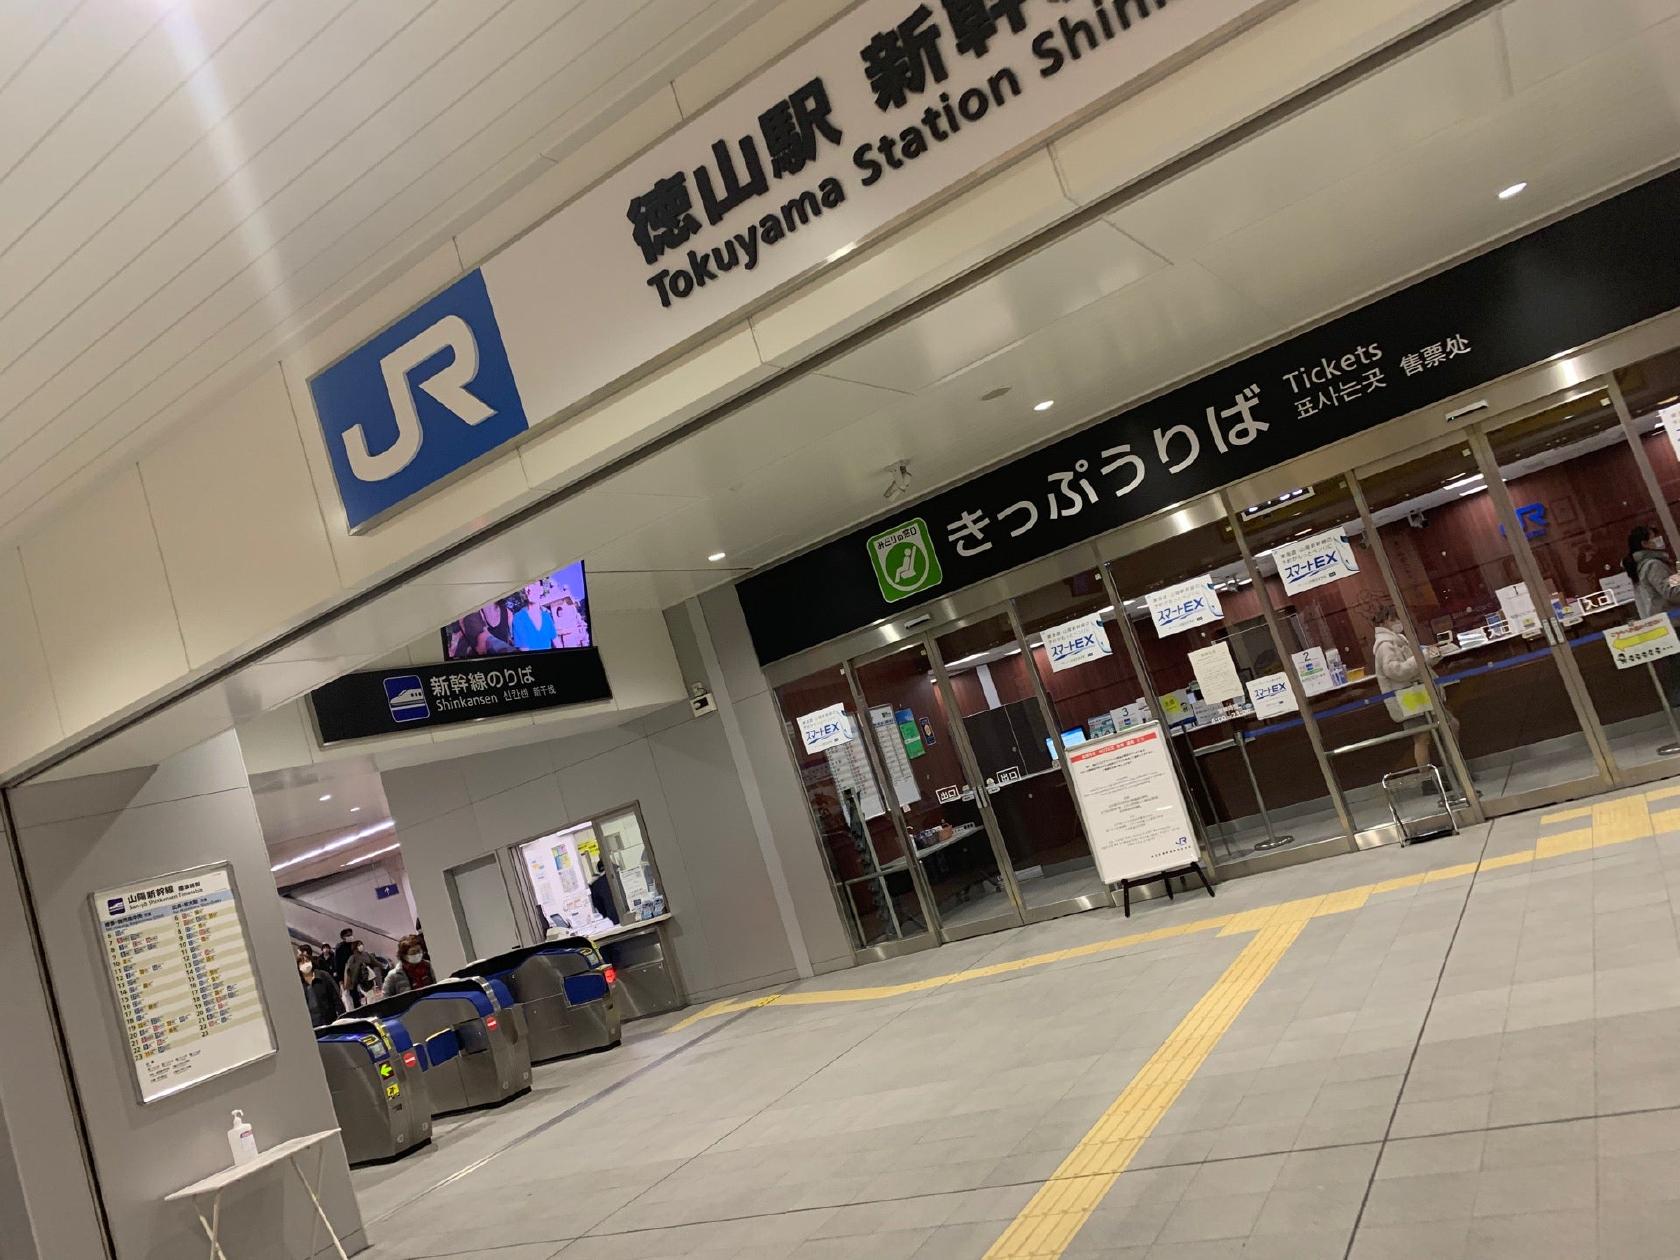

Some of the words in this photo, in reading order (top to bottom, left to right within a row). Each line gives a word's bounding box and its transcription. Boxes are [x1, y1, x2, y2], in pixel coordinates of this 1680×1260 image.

[647, 174, 846, 307] Tokuyama
[852, 64, 1021, 186] Station
[1031, 0, 1168, 78] Shin
[626, 76, 843, 264] 徳山駅
[1283, 343, 1383, 393] Tickets
[1400, 333, 1472, 377] 售票处
[341, 314, 497, 482] JR
[945, 383, 1271, 559] きっぷうりば
[1285, 550, 1338, 579] スマートEX
[1158, 596, 1204, 622] スマートEX
[1584, 595, 1610, 610] 入口
[1051, 634, 1095, 657] スマートEX
[1303, 652, 1311, 662] 2
[430, 665, 535, 697] 新幹線のりば
[436, 695, 498, 711] Shinkansen
[1122, 707, 1129, 716] 3
[1000, 771, 1018, 781] 出口
[940, 789, 956, 800] 出口
